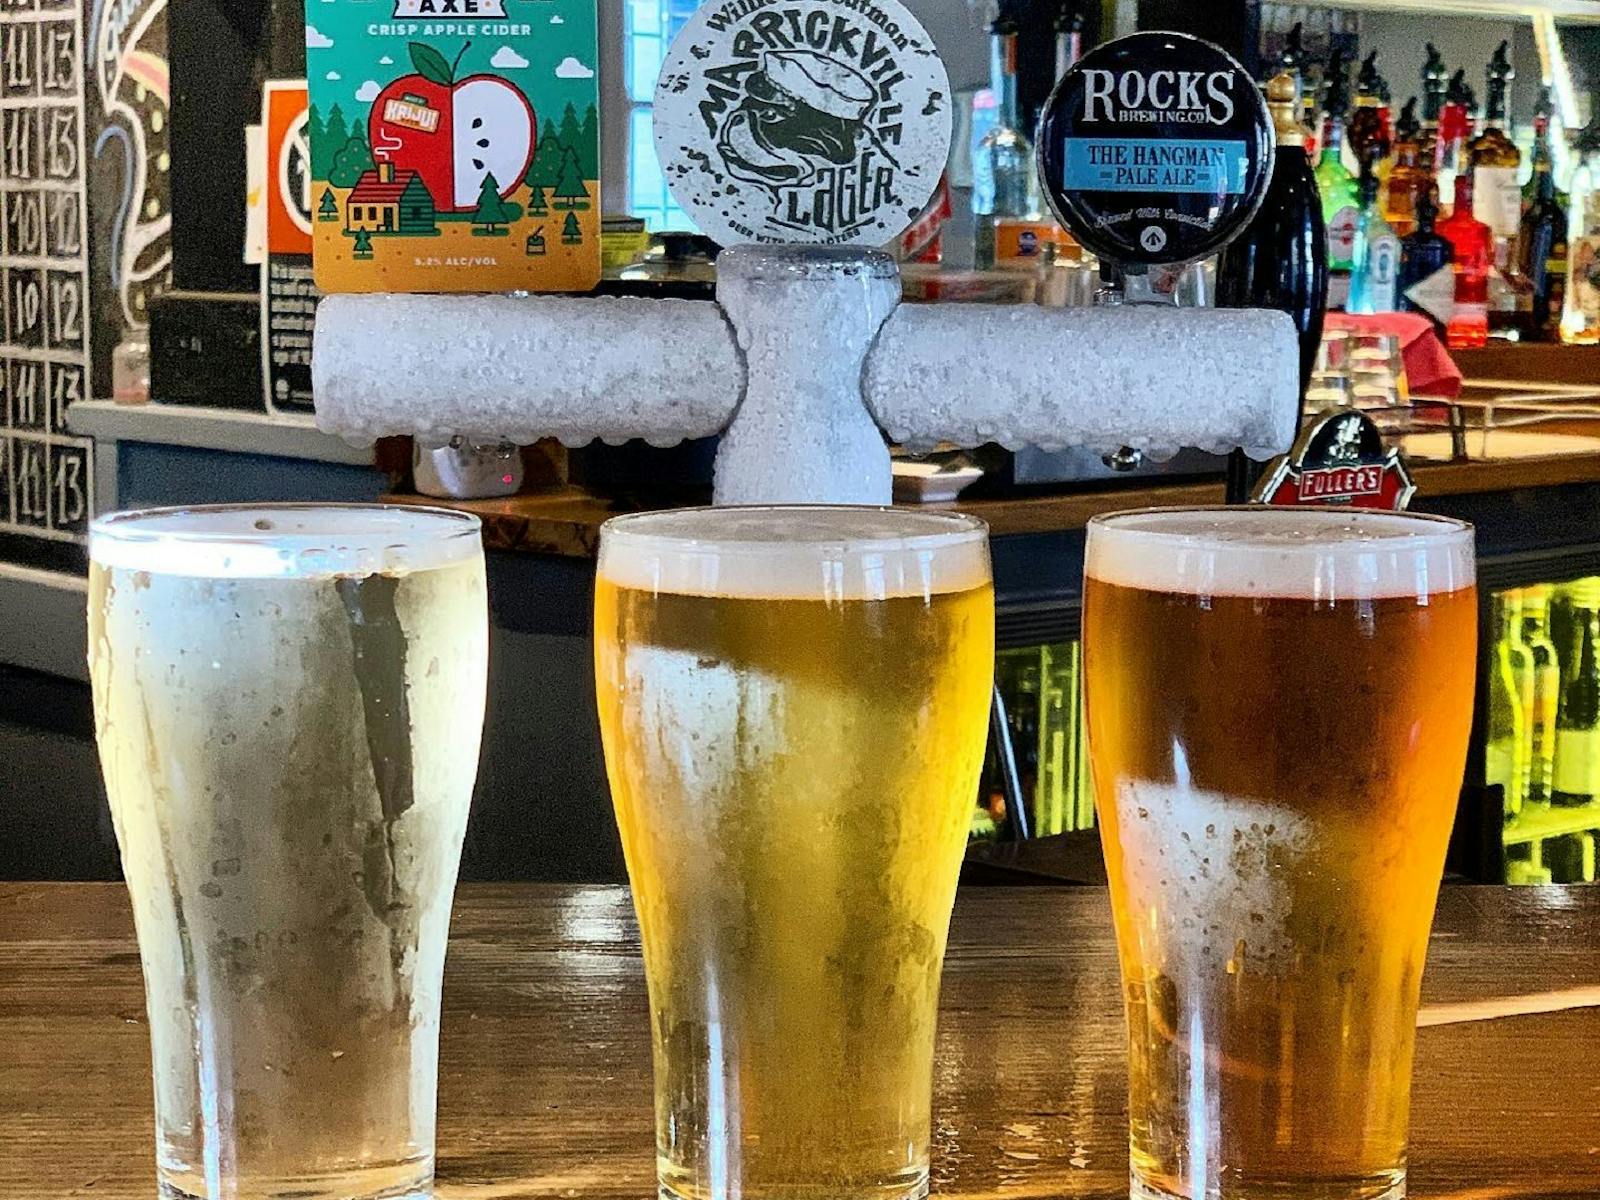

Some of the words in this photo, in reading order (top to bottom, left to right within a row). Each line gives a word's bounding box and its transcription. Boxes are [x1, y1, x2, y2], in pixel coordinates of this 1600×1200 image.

[419, 0, 478, 13] AXE
[367, 24, 419, 36] CRISP
[423, 24, 477, 36] APPLE
[481, 24, 532, 36] CIDER
[45, 29, 77, 90] 13
[698, 9, 904, 146] MARRICKVILLE
[1081, 69, 1235, 125] ROCKS
[48, 111, 77, 178] 13
[1088, 145, 1128, 165] THE
[1133, 146, 1225, 167] HANGMAN
[1115, 168, 1158, 185] PALE
[1162, 168, 1196, 186] ALE
[728, 219, 754, 239] BEER
[445, 255, 497, 267] ALC/VOL
[16, 280, 39, 334] 10
[52, 280, 80, 342] 12
[55, 454, 84, 524] 13
[1303, 468, 1378, 495] FULLER'S
